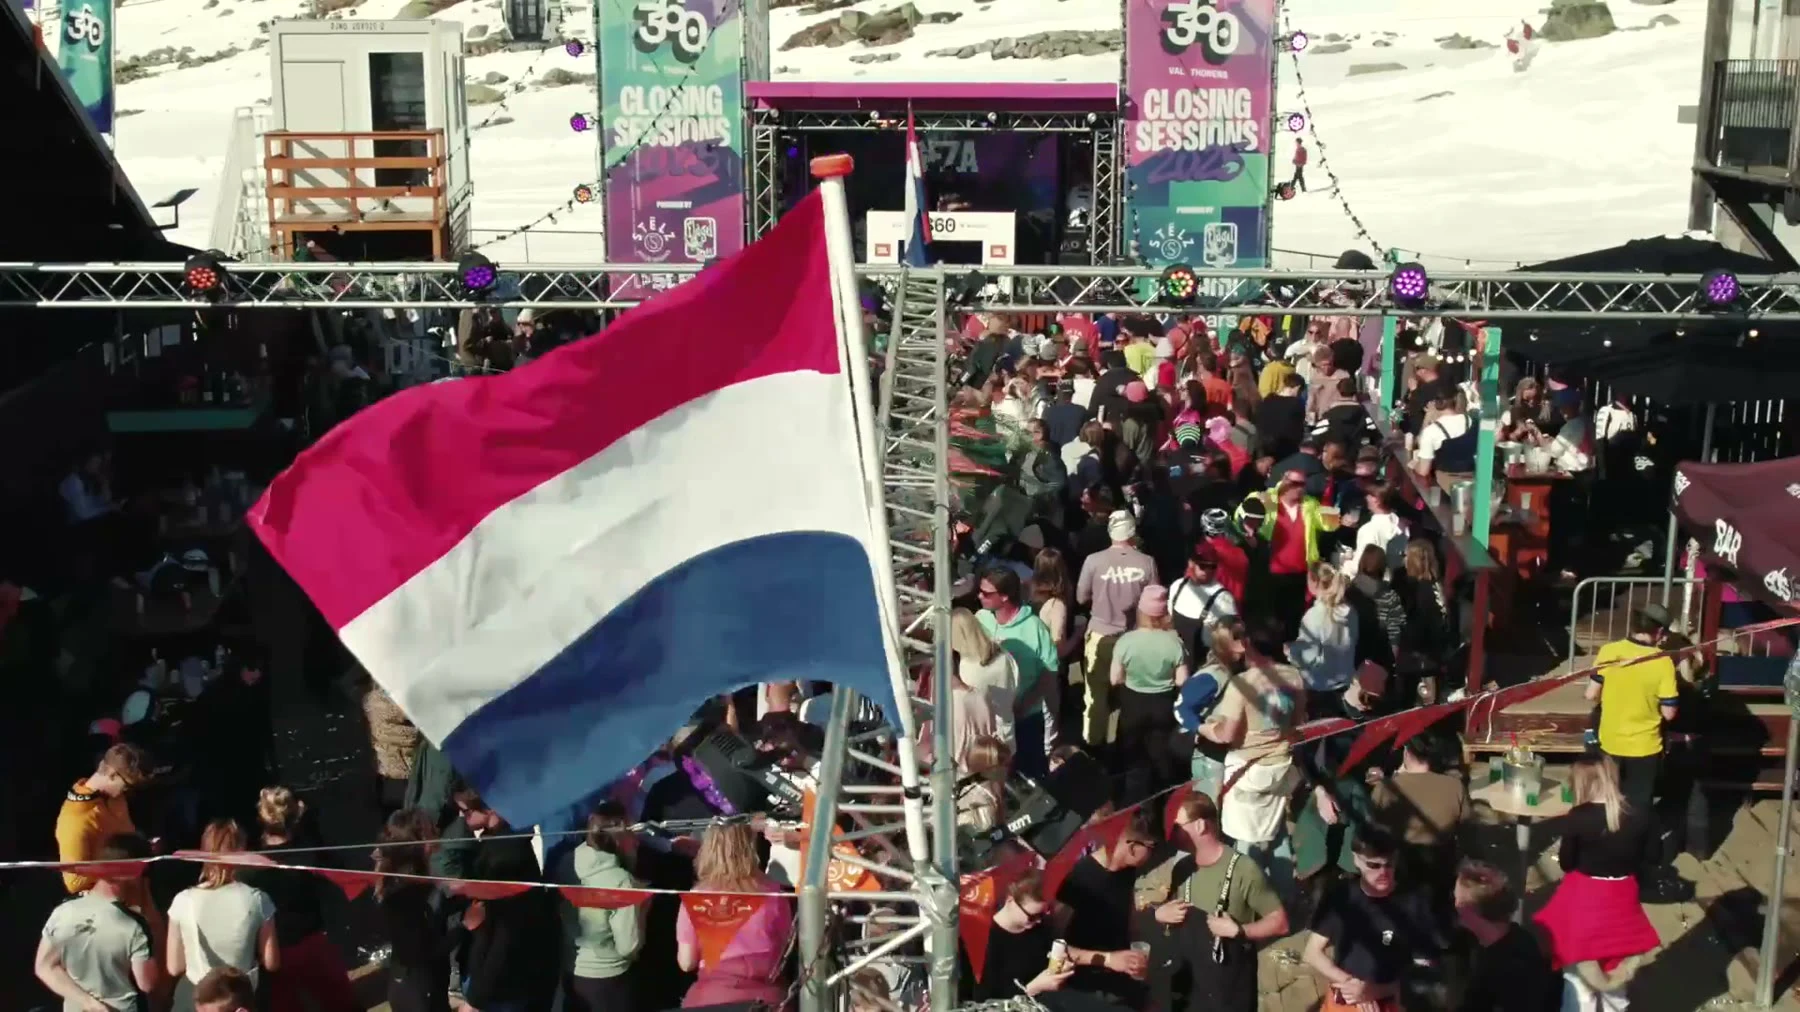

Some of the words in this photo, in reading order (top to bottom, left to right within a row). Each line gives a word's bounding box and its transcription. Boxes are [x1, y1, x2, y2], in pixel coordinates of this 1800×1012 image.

[638, 0, 708, 53] 360
[1167, 0, 1239, 55] 360
[620, 84, 723, 117] CLOSING
[1143, 87, 1252, 121] CLOSING
[613, 115, 731, 147] SESSIONS
[1135, 119, 1259, 152] SESSIONS
[1149, 222, 1195, 249] STELZ
[1713, 517, 1743, 569] BAR
